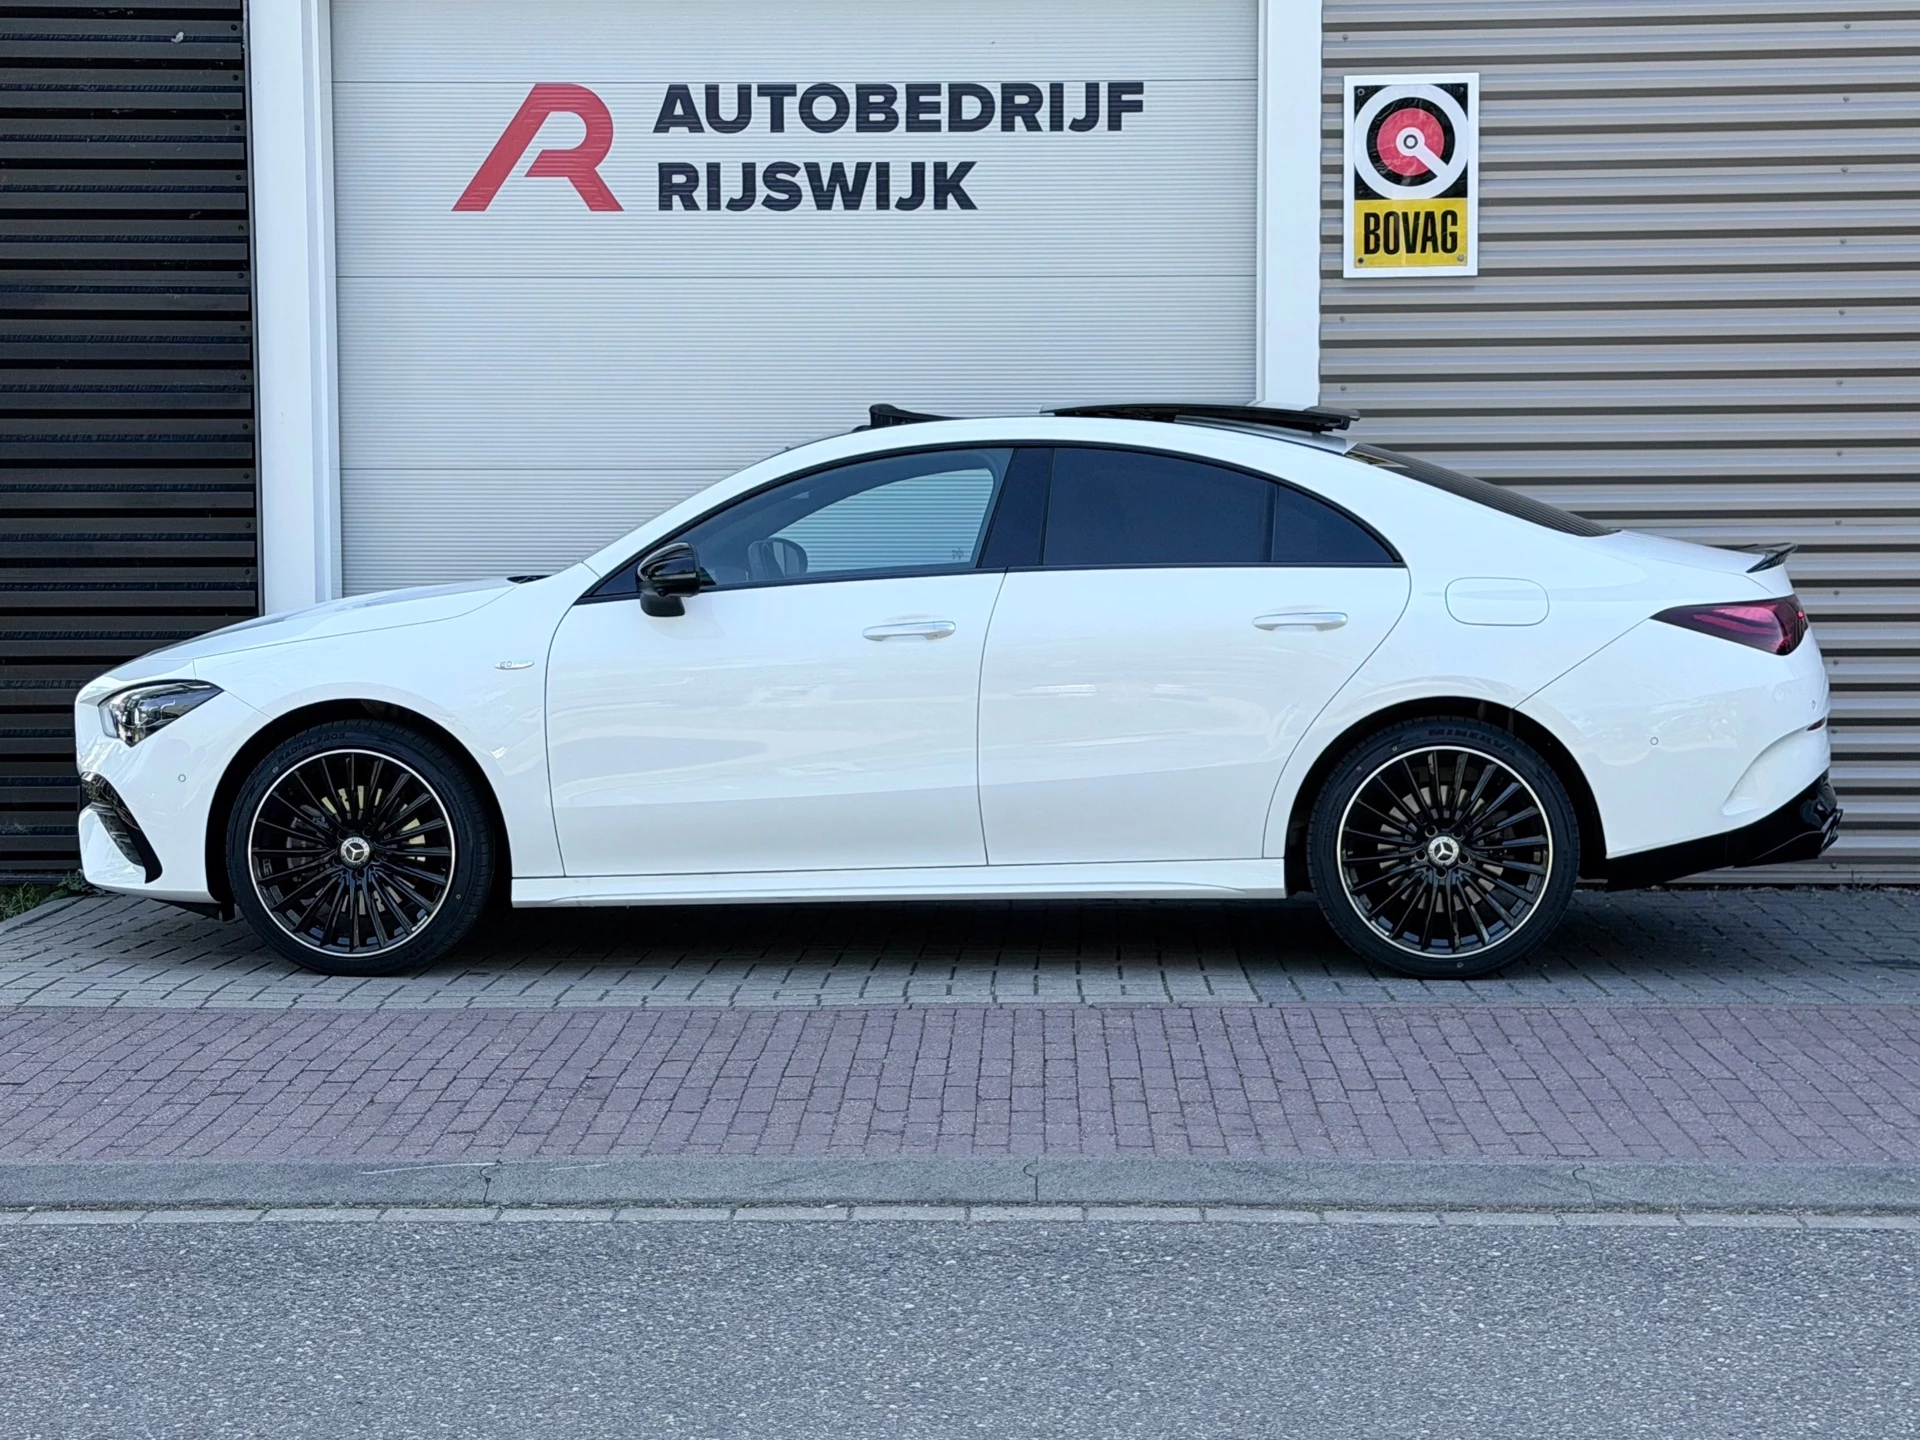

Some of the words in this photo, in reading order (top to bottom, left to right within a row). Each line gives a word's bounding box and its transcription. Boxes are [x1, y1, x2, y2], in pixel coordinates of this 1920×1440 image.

[653, 82, 1144, 134] AUTOBEDRIJF
[658, 161, 978, 211] RIJSWIJK
[1363, 209, 1459, 256] BOVAG
